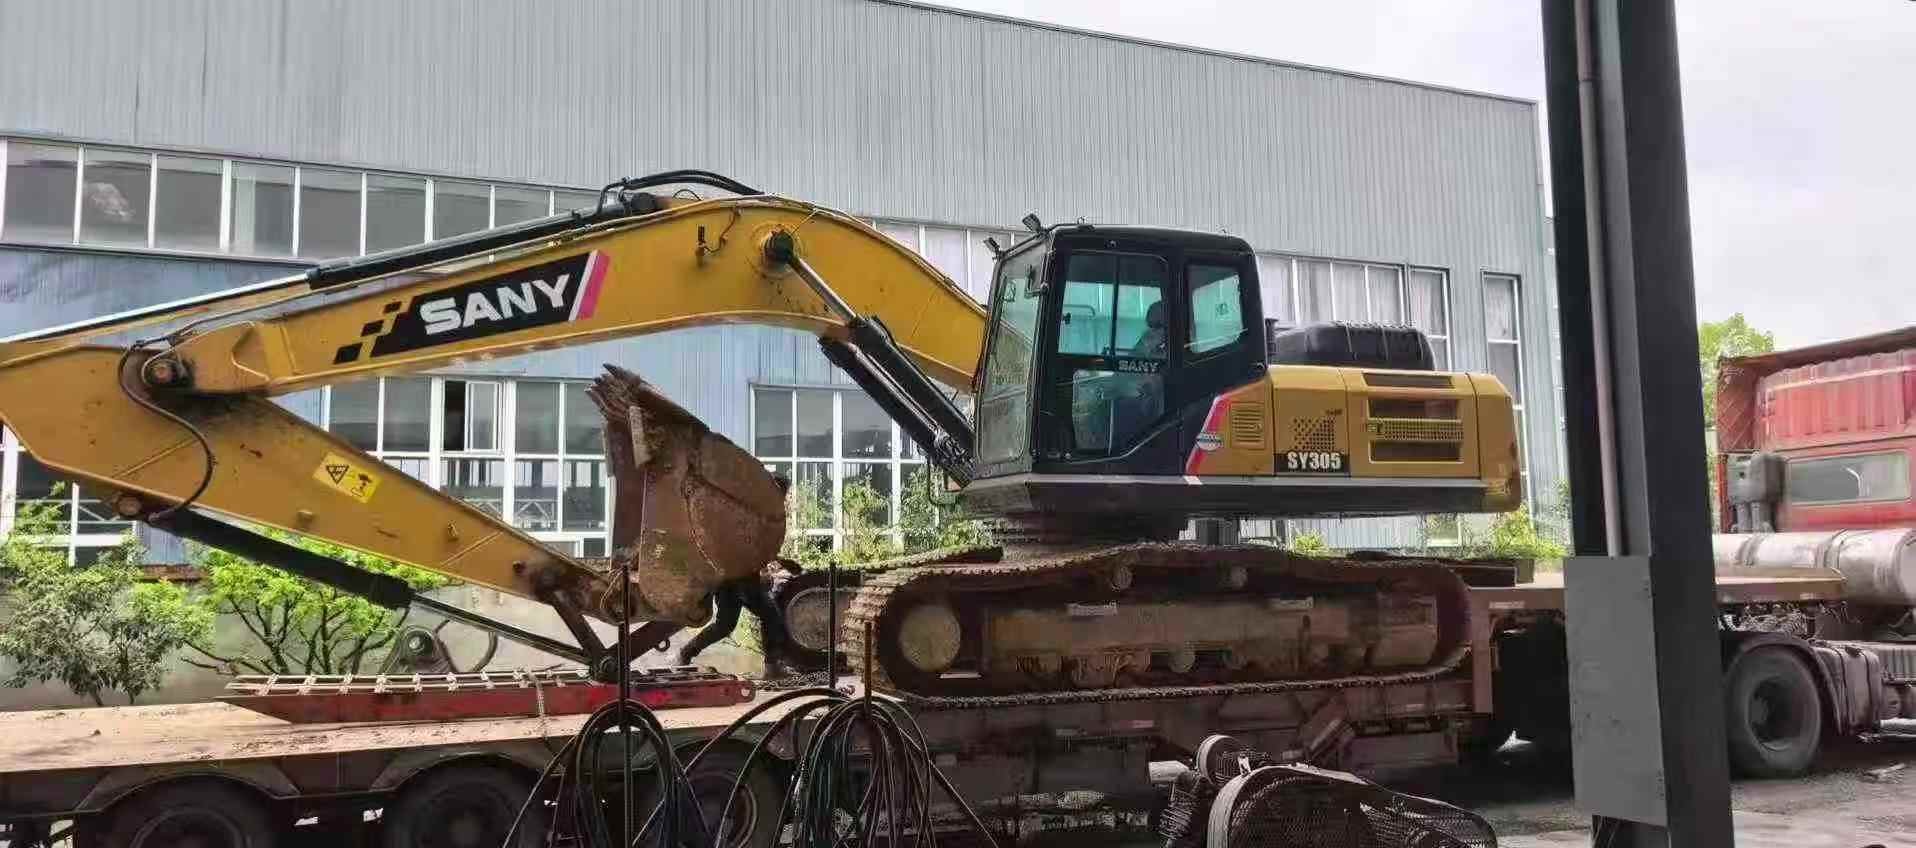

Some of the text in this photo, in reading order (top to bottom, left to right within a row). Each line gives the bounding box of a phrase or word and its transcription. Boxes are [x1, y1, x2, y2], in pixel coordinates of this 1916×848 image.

[420, 274, 570, 335] SANY
[1118, 360, 1159, 372] SANY
[1287, 451, 1341, 470] SY305
